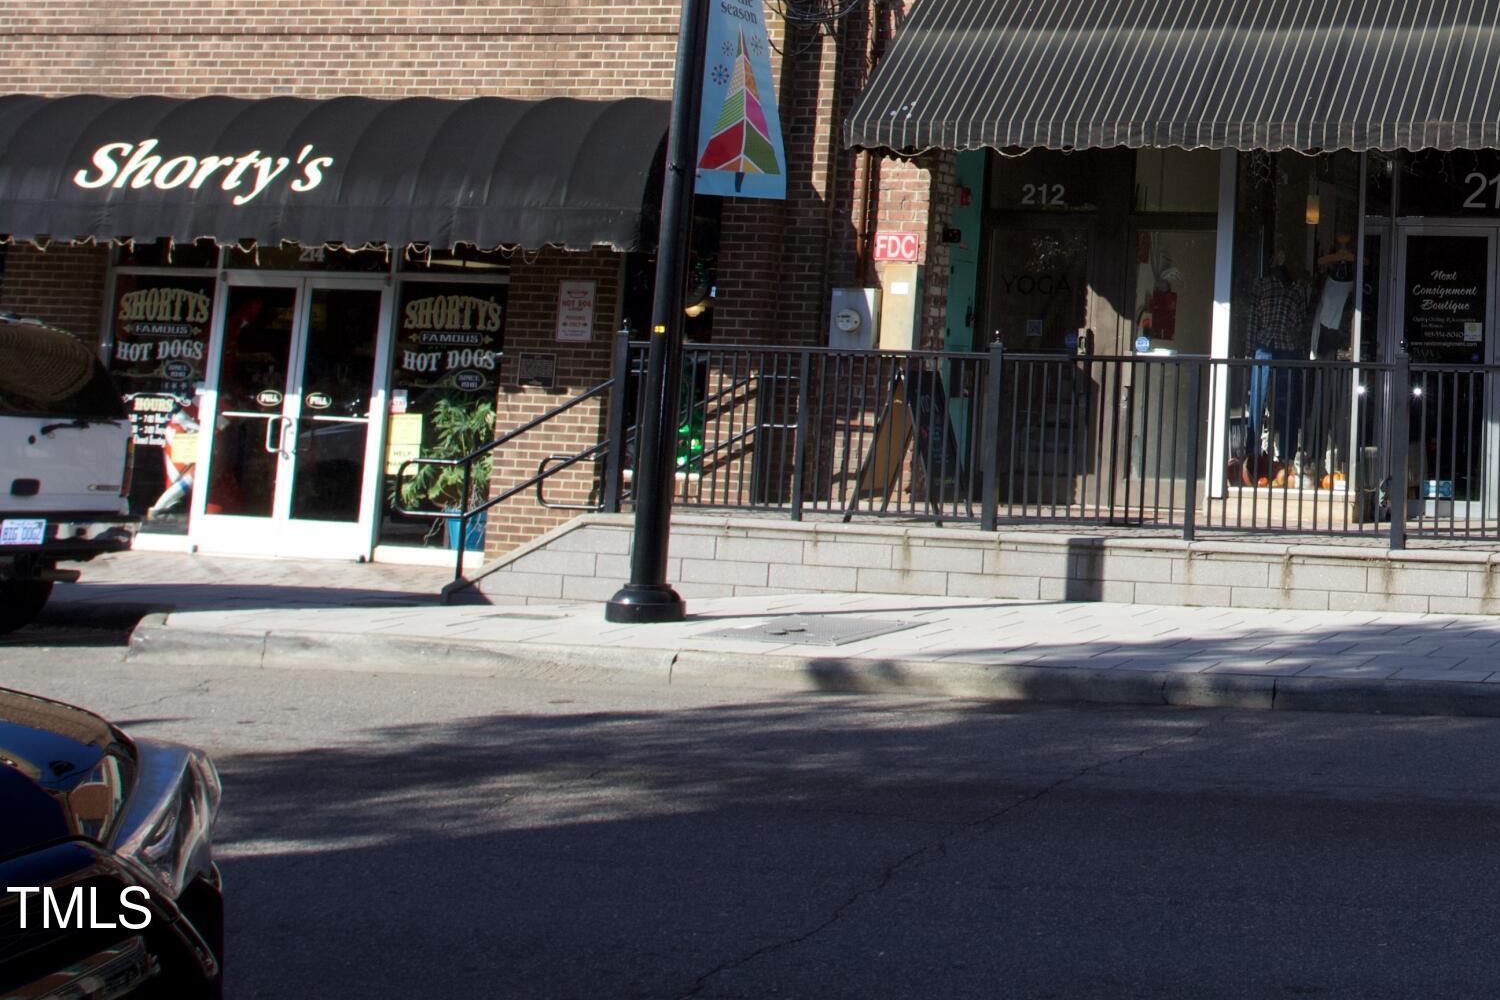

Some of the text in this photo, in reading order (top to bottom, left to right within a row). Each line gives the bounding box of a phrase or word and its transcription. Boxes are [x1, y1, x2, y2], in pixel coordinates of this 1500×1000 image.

[720, 0, 757, 25] season
[74, 138, 333, 206] Shorty's
[1022, 184, 1065, 205] 212
[876, 235, 915, 258] FDC
[299, 250, 325, 262] 214
[1430, 269, 1457, 281] Next
[1412, 284, 1478, 299] Consignment
[119, 287, 210, 323] SHORTY'S
[1420, 299, 1471, 314] Boutique
[404, 295, 502, 332] SHORTY'S
[135, 325, 188, 334] FAMOUS
[422, 333, 479, 343] FAMOUS
[116, 339, 204, 362] HOT DOGS
[402, 349, 442, 372] HOT
[446, 348, 496, 371] DOGS
[133, 397, 174, 412] HOURS
[261, 394, 278, 403] PULL
[309, 396, 327, 406] PULL
